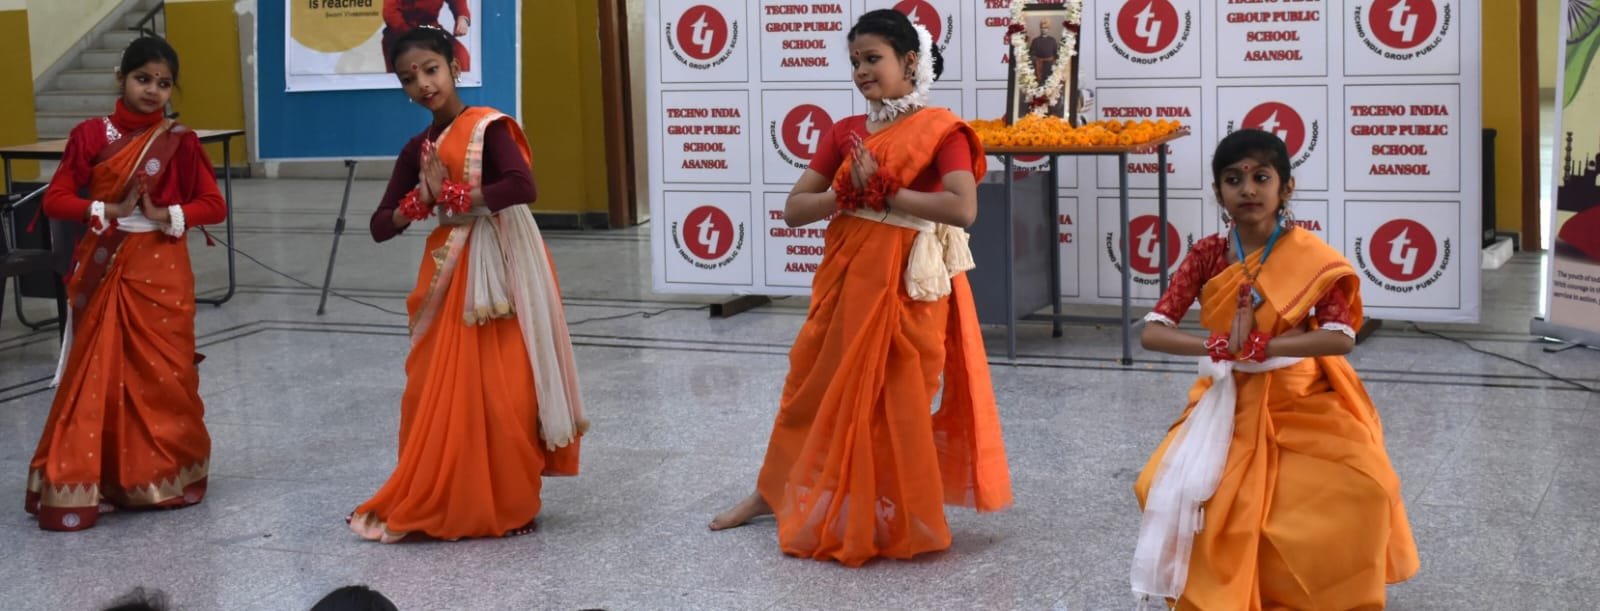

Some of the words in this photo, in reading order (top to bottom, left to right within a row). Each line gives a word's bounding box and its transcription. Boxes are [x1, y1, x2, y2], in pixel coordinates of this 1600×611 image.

[765, 5, 808, 15] TECHNO
[811, 4, 842, 14] INDIA
[1226, 12, 1271, 23] GROUP
[1272, 10, 1320, 22] PUBLIC
[765, 22, 802, 32] GROUP
[803, 21, 842, 32] PUBLIC
[944, 14, 953, 44] SCHOOL
[1354, 6, 1365, 38] TECHNO
[1363, 38, 1382, 55] INDIA
[1384, 52, 1413, 60] GROUP
[1416, 37, 1442, 58] PUBLIC
[1440, 3, 1451, 35] SCHOOL
[1104, 13, 1114, 43] TECHNO
[1112, 43, 1130, 60] INDIA
[1131, 56, 1158, 64] GROUP
[1159, 42, 1184, 62] PUBLIC
[1181, 10, 1191, 41] SCHOOL
[1247, 30, 1300, 42] SCHOOL
[672, 49, 687, 66] INDIA
[689, 62, 711, 70] GROUP
[712, 49, 732, 67] PUBLIC
[730, 20, 738, 48] SCHOOL
[782, 39, 826, 50] SCHOOL
[1243, 50, 1303, 61] ASANSOL
[780, 57, 829, 67] ASANSOL
[666, 108, 708, 118] TECHNO
[711, 108, 741, 118] INDIA
[1102, 106, 1152, 117] TECHNO
[1156, 106, 1191, 117] INDIA
[1350, 105, 1406, 116] TECHNO
[1410, 104, 1449, 116] INDIA
[667, 125, 703, 135] GROUP
[704, 125, 741, 135] PUBLIC
[1351, 125, 1397, 136] GROUP
[1399, 124, 1448, 136] PUBLIC
[683, 142, 726, 152] SCHOOL
[770, 120, 779, 150] TECHNO
[777, 149, 793, 165] INDIA
[1291, 151, 1311, 170] UBLIC
[1308, 119, 1319, 152] SCHOOL
[1372, 144, 1428, 155] SCHOOL
[681, 159, 728, 169] ASANSOL
[1368, 164, 1430, 175] ASANSOL
[770, 227, 806, 238] GROUP
[1106, 232, 1116, 263] TECHNO
[678, 249, 694, 265] INDIA
[694, 262, 717, 270] GROUP
[718, 250, 738, 268] PUBLIC
[1355, 236, 1366, 269] TECHNO
[1364, 269, 1383, 287] INDIA
[1384, 284, 1413, 293] GROUP
[1416, 270, 1442, 291] PUBLIC
[1440, 236, 1450, 270] SCHOOL
[784, 262, 819, 273] ASANS
